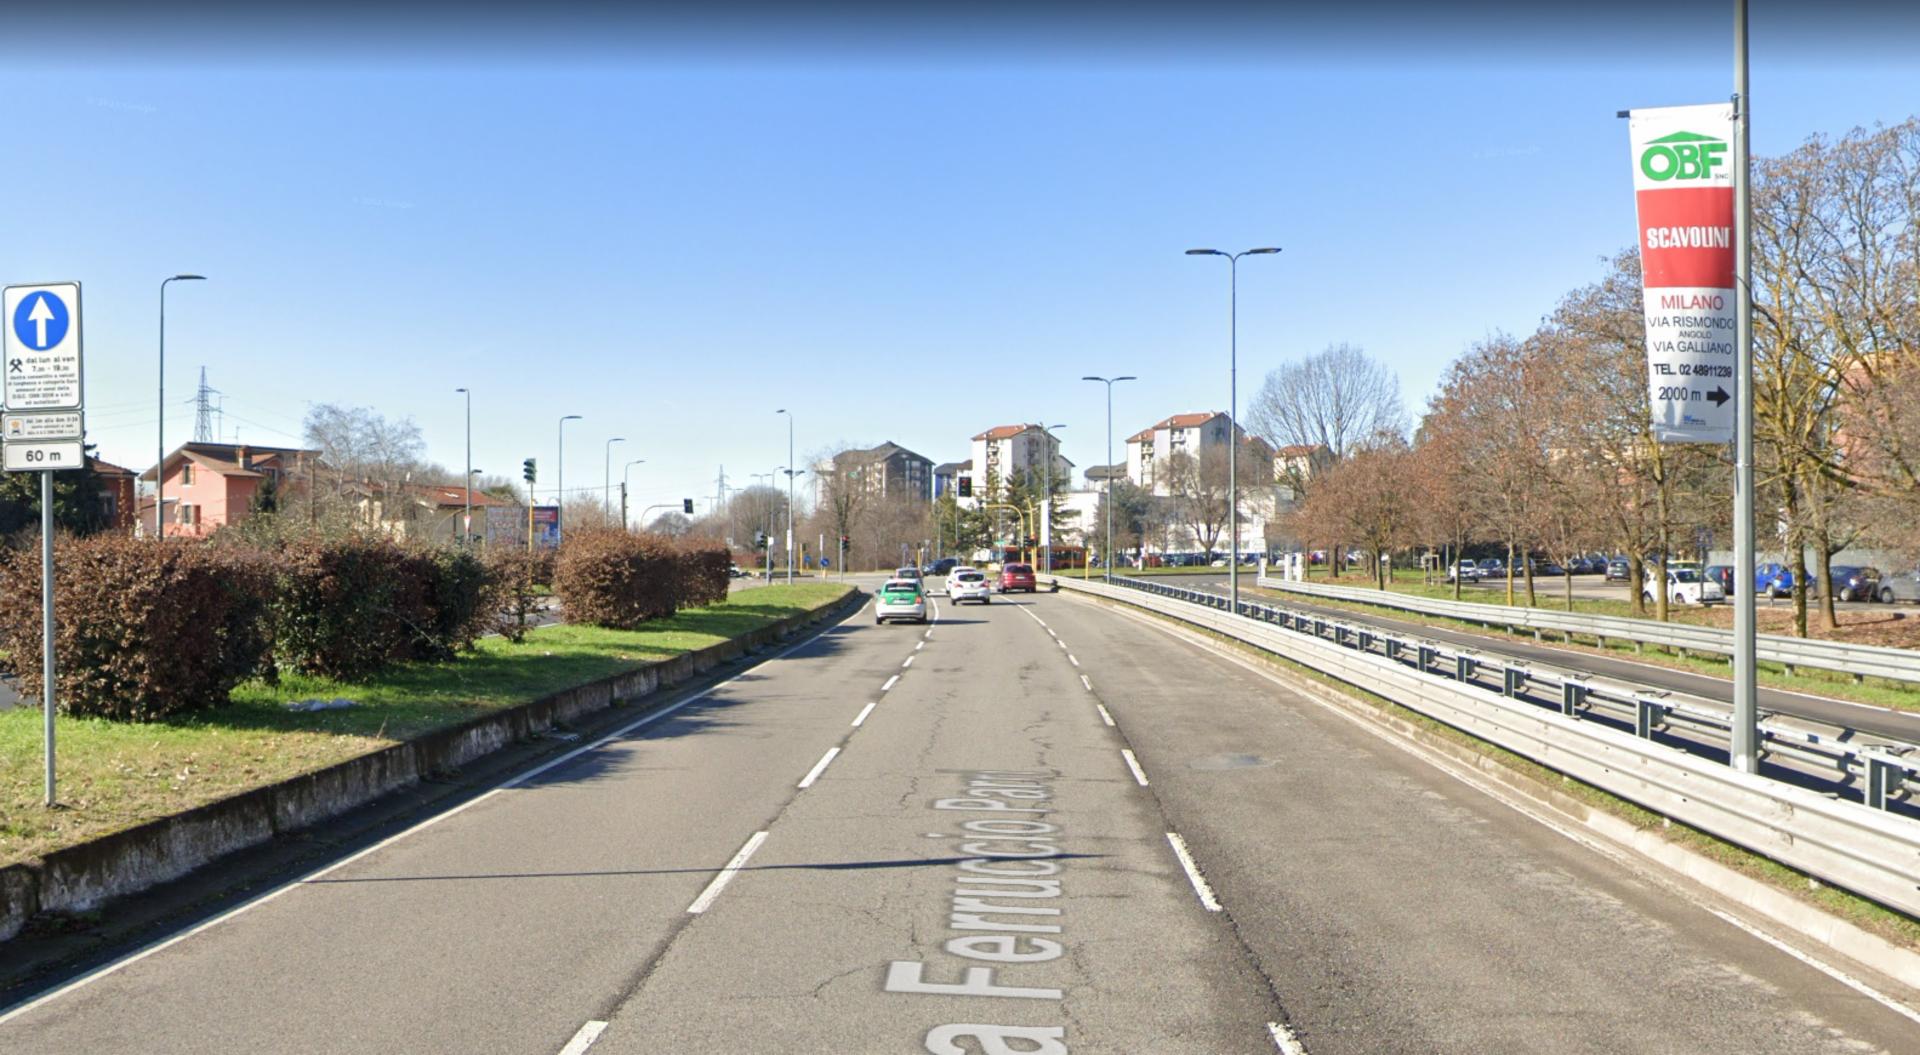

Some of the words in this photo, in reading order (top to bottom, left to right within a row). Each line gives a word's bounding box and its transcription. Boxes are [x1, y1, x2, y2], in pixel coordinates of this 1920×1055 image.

[1640, 143, 1728, 182] OBF
[1646, 226, 1730, 249] SCAVOLINI
[1661, 295, 1724, 310] MILANO
[1648, 316, 1671, 328] VIA
[1673, 316, 1734, 330] RISMONDO
[1678, 331, 1712, 340] ANGOLO
[1653, 341, 1675, 352] VIA
[1677, 341, 1733, 355] GALLIANO
[1653, 364, 1676, 375] TEL.
[1679, 364, 1691, 375] 02
[1659, 386, 1688, 401] 2000
[1691, 390, 1701, 401] m
[25, 450, 43, 462] 60
[50, 452, 61, 461] m
